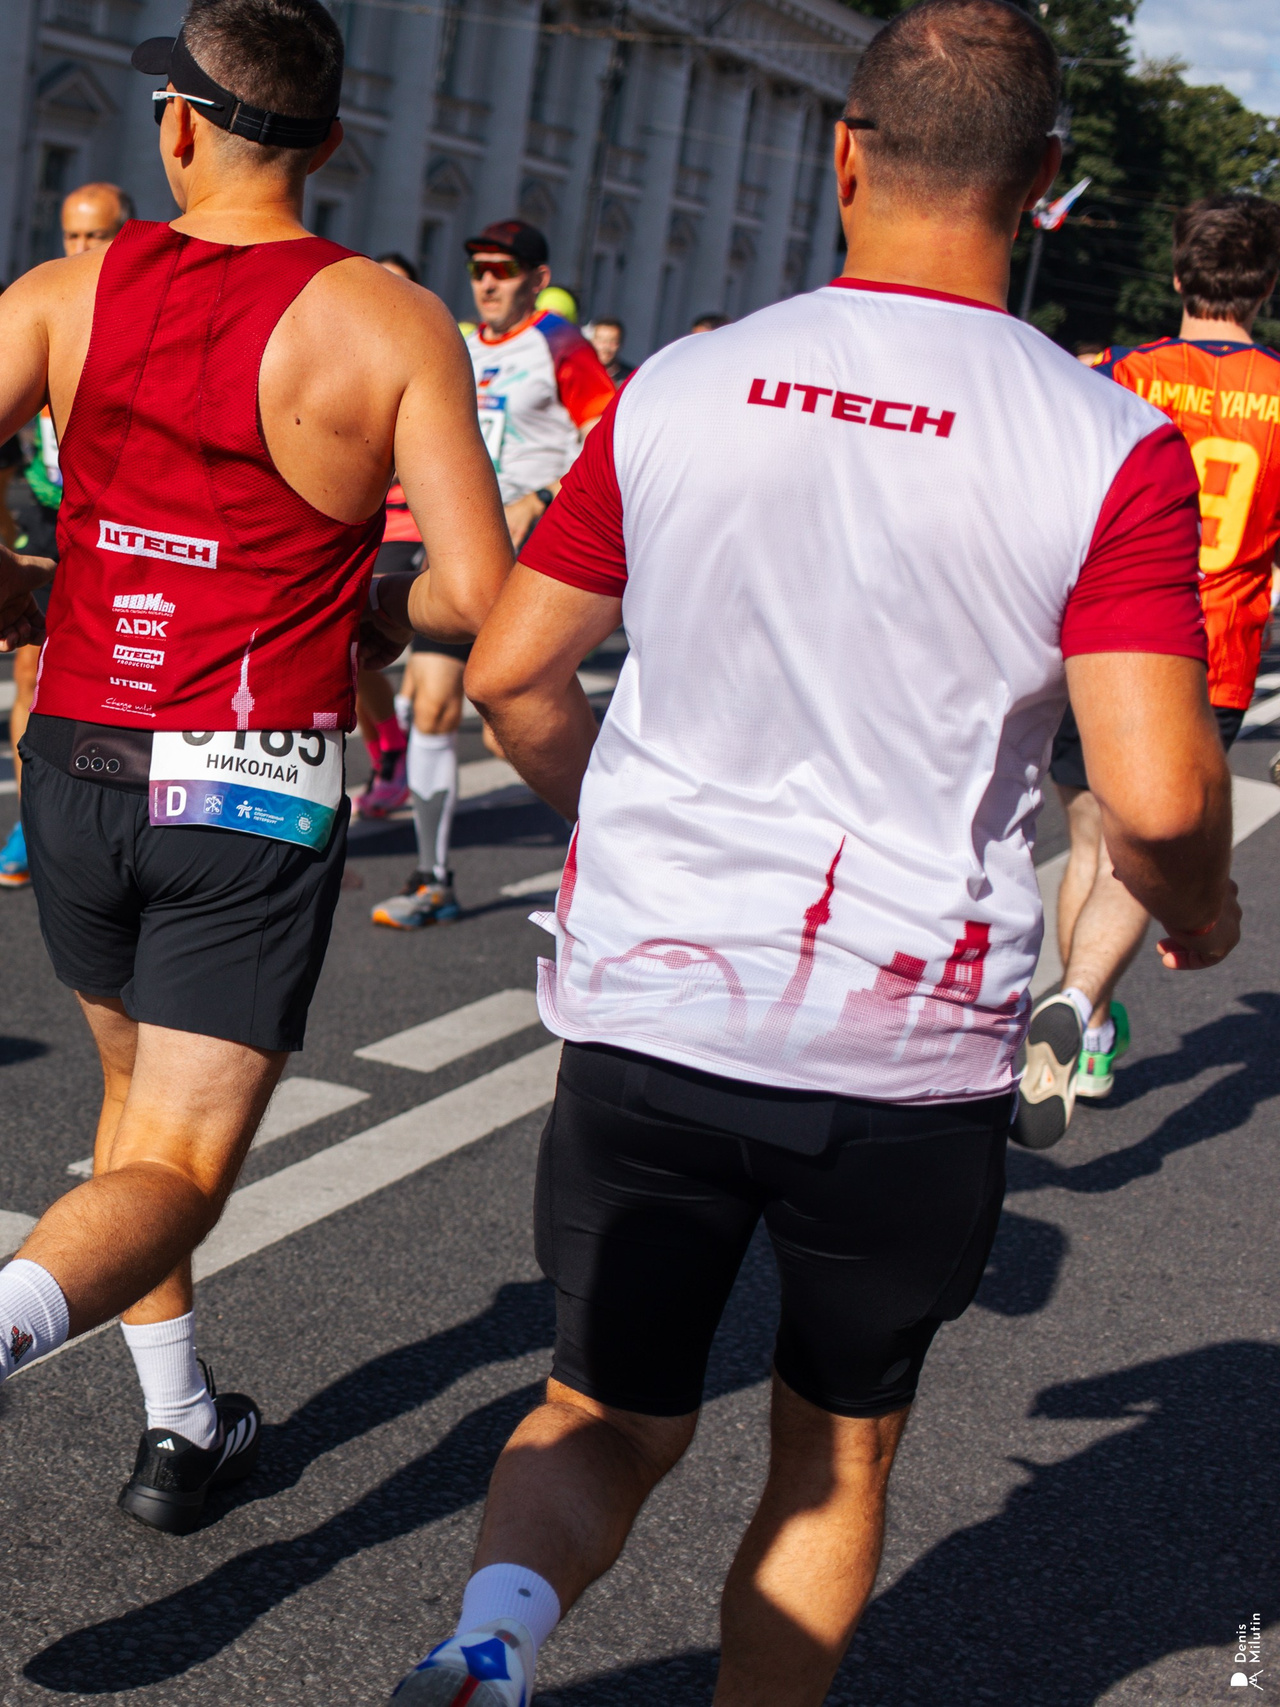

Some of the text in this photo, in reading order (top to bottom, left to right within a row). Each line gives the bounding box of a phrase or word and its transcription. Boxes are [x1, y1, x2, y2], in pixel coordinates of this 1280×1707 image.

[747, 378, 957, 438] UTECH
[104, 527, 211, 563] UTECH
[115, 617, 169, 638] ADK
[116, 648, 162, 664] UTECH
[117, 659, 156, 670] PRODUCTION
[109, 676, 157, 693] UTOOL
[206, 753, 299, 784] НИКОЛАЙ
[166, 785, 187, 817] D
